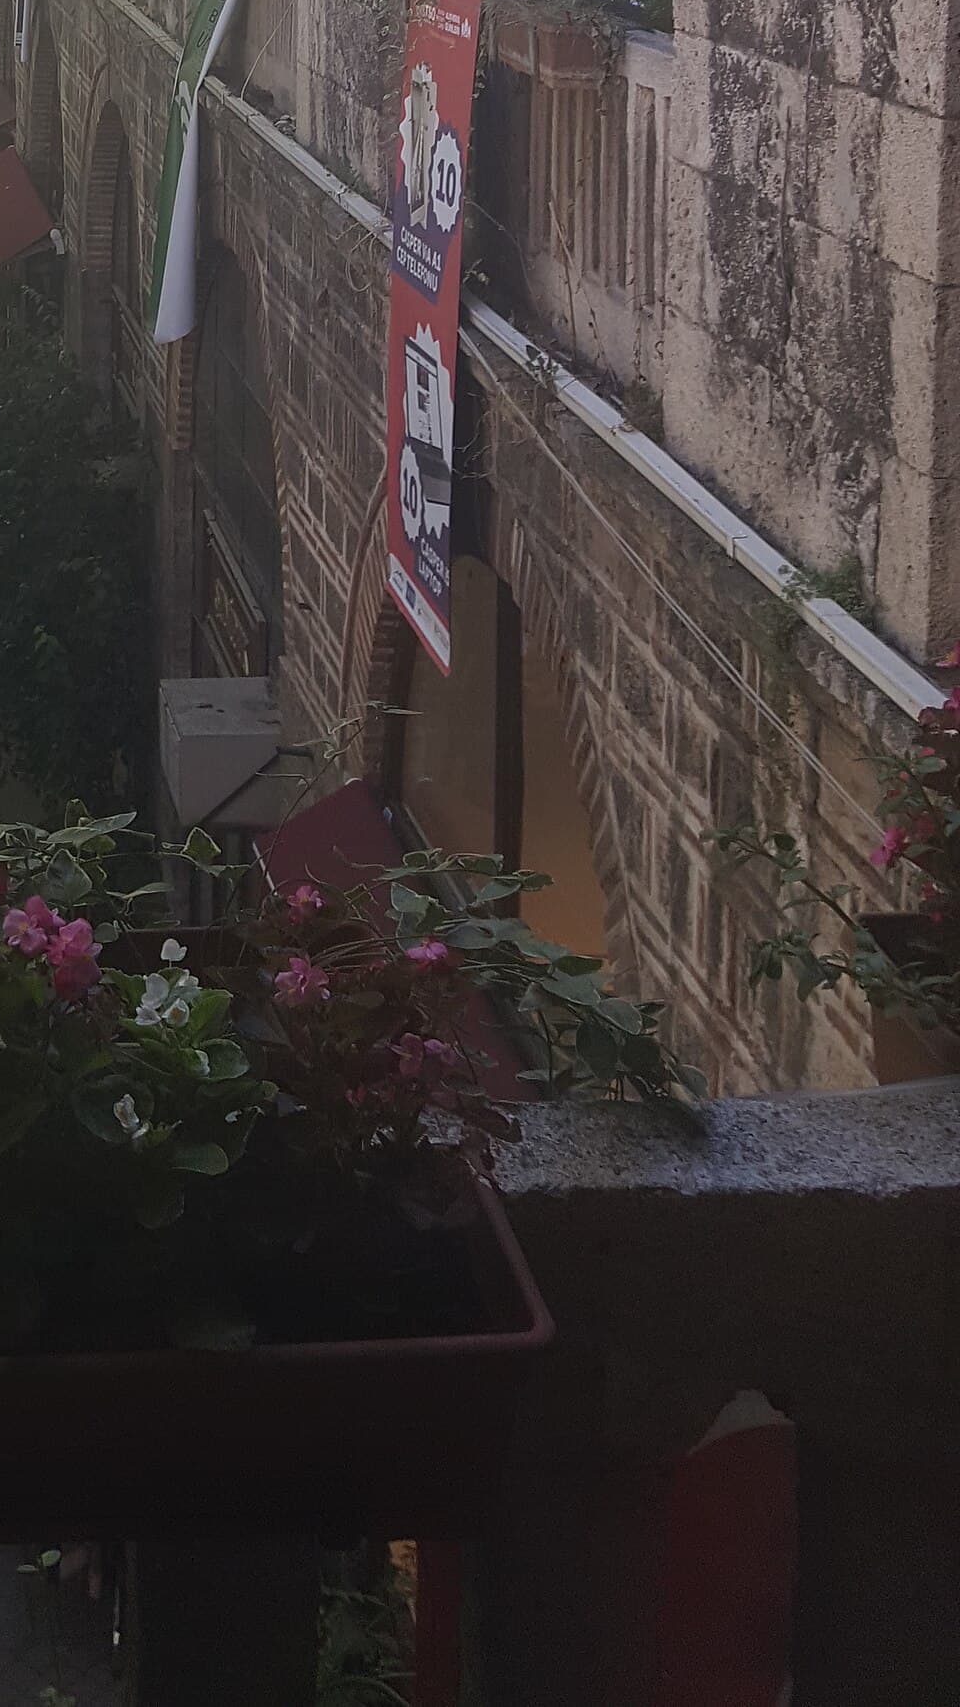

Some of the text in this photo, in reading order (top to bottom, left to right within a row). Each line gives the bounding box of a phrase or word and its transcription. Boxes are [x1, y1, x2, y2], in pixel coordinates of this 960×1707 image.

[436, 158, 456, 207] 10
[401, 226, 422, 257] CASPER
[432, 251, 441, 271] A1
[407, 253, 438, 292] TELEFONU
[403, 467, 417, 519] 10
[419, 555, 441, 596] LAPTOP
[421, 538, 444, 580] CASPER
